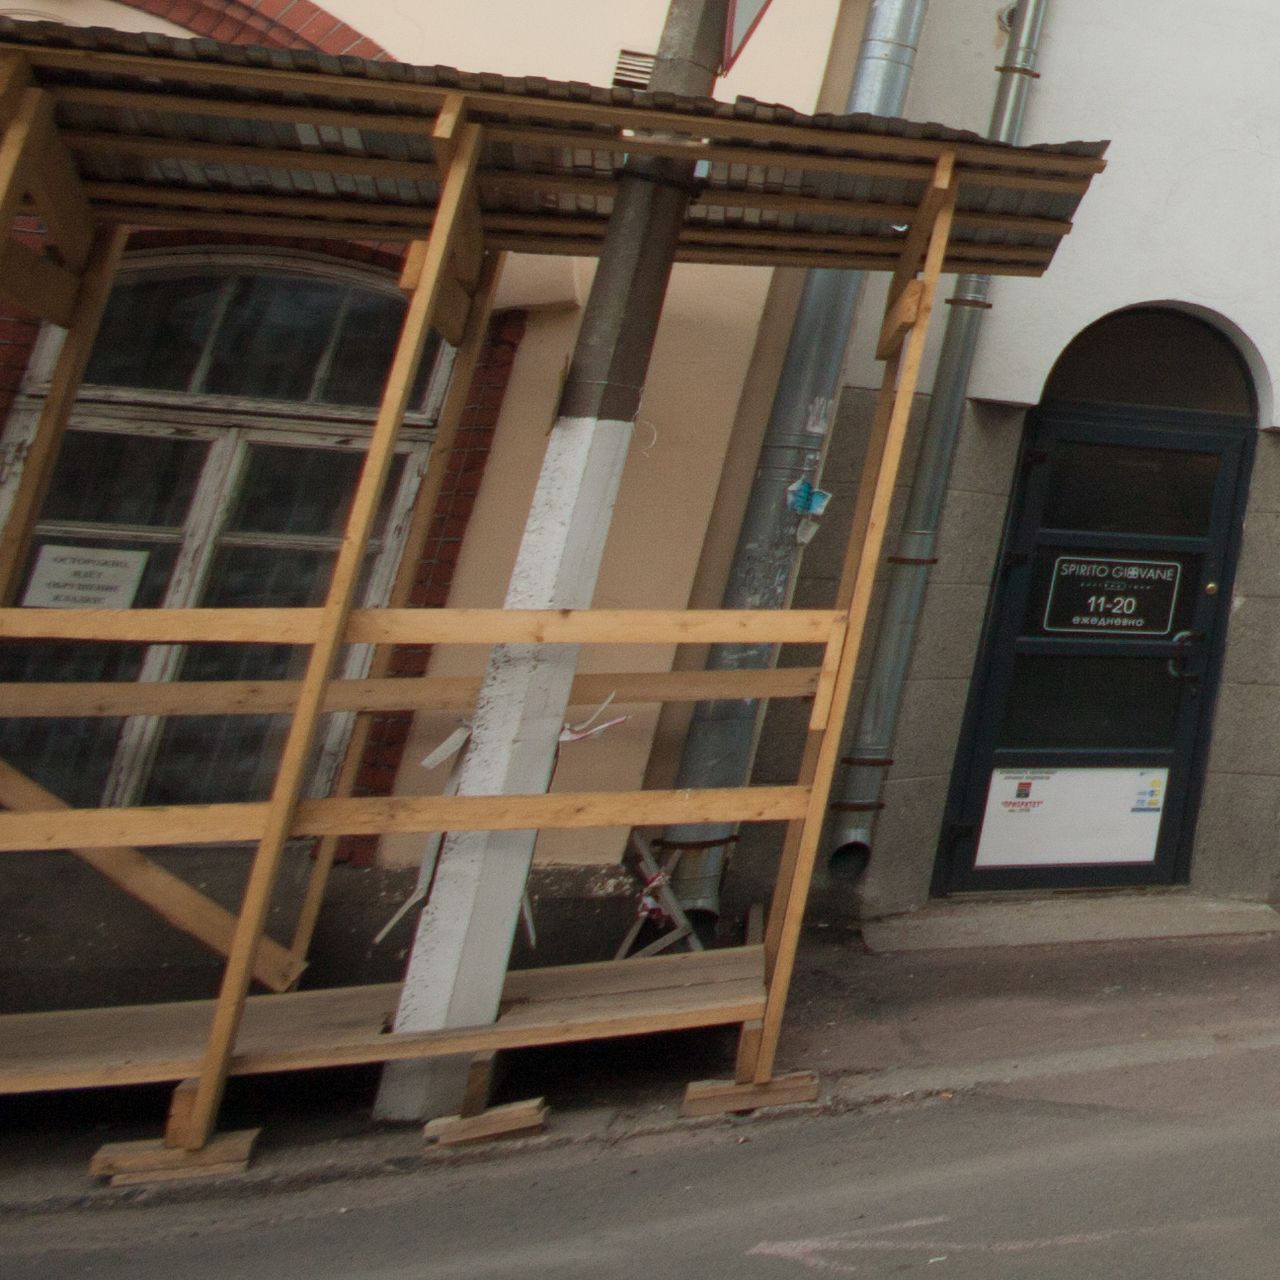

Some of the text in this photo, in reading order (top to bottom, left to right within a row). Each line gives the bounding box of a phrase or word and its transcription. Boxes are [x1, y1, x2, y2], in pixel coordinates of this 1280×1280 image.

[1060, 563, 1175, 581] SPIRITO GIOVANE
[1087, 595, 1137, 615] 11-20
[1072, 616, 1145, 627] ежедневно
